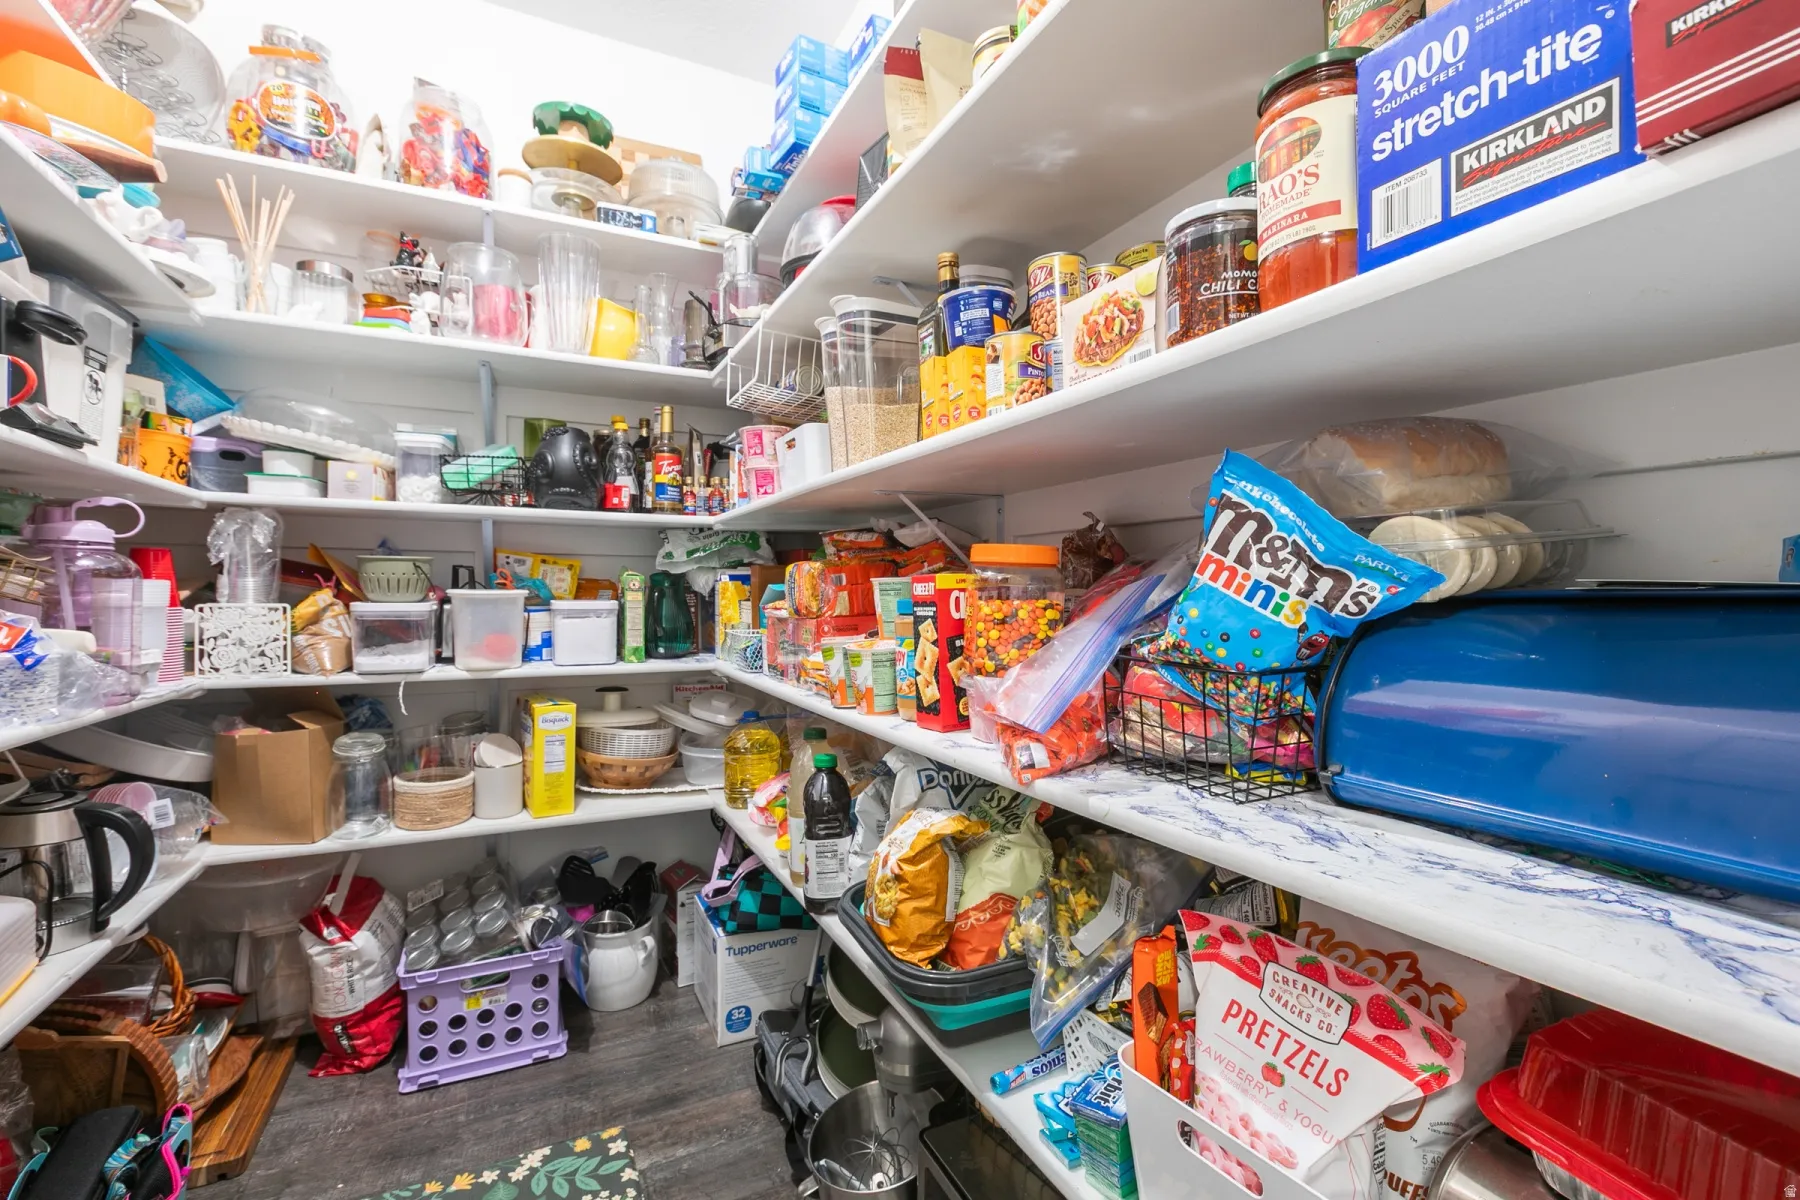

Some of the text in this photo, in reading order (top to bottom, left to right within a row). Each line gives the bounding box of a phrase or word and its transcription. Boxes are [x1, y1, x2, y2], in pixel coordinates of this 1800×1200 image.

[1384, 9, 1411, 33] Spices
[1495, 11, 1507, 20] cm
[1671, 0, 1737, 35] KIRK
[1372, 25, 1470, 107] 3000
[1371, 23, 1603, 161] stretch-tite
[1374, 82, 1428, 118] SQUARE
[1431, 60, 1466, 87] FEET
[1463, 96, 1607, 174] KIRKLAND
[1462, 122, 1607, 189] Signature
[1258, 163, 1320, 214] RAO'S
[1261, 188, 1311, 220] HOMEMADE
[1385, 180, 1402, 194] ITEM
[1262, 211, 1309, 241] MARINARA
[1200, 280, 1241, 295] CHILI
[1221, 270, 1258, 279] MOMO
[1261, 493, 1326, 552] chocolate
[1196, 552, 1308, 626] minis
[675, 684, 724, 692] KitchenAid
[541, 715, 570, 725] Bisquick
[1114, 881, 1126, 918] Ziploc
[1242, 910, 1250, 923] 140
[725, 936, 798, 957] Tupperware
[1156, 952, 1164, 986] KING
[1163, 949, 1173, 985] SIZE
[1268, 988, 1312, 1024] SNACKS
[1272, 970, 1344, 1016] CREATIVE
[731, 1007, 746, 1019] 32
[1221, 998, 1350, 1097] PRETZELS
[1031, 1053, 1066, 1078] entos
[1091, 1075, 1123, 1108] rbit
[1195, 1038, 1340, 1146] RAWBERRY & YOGU
